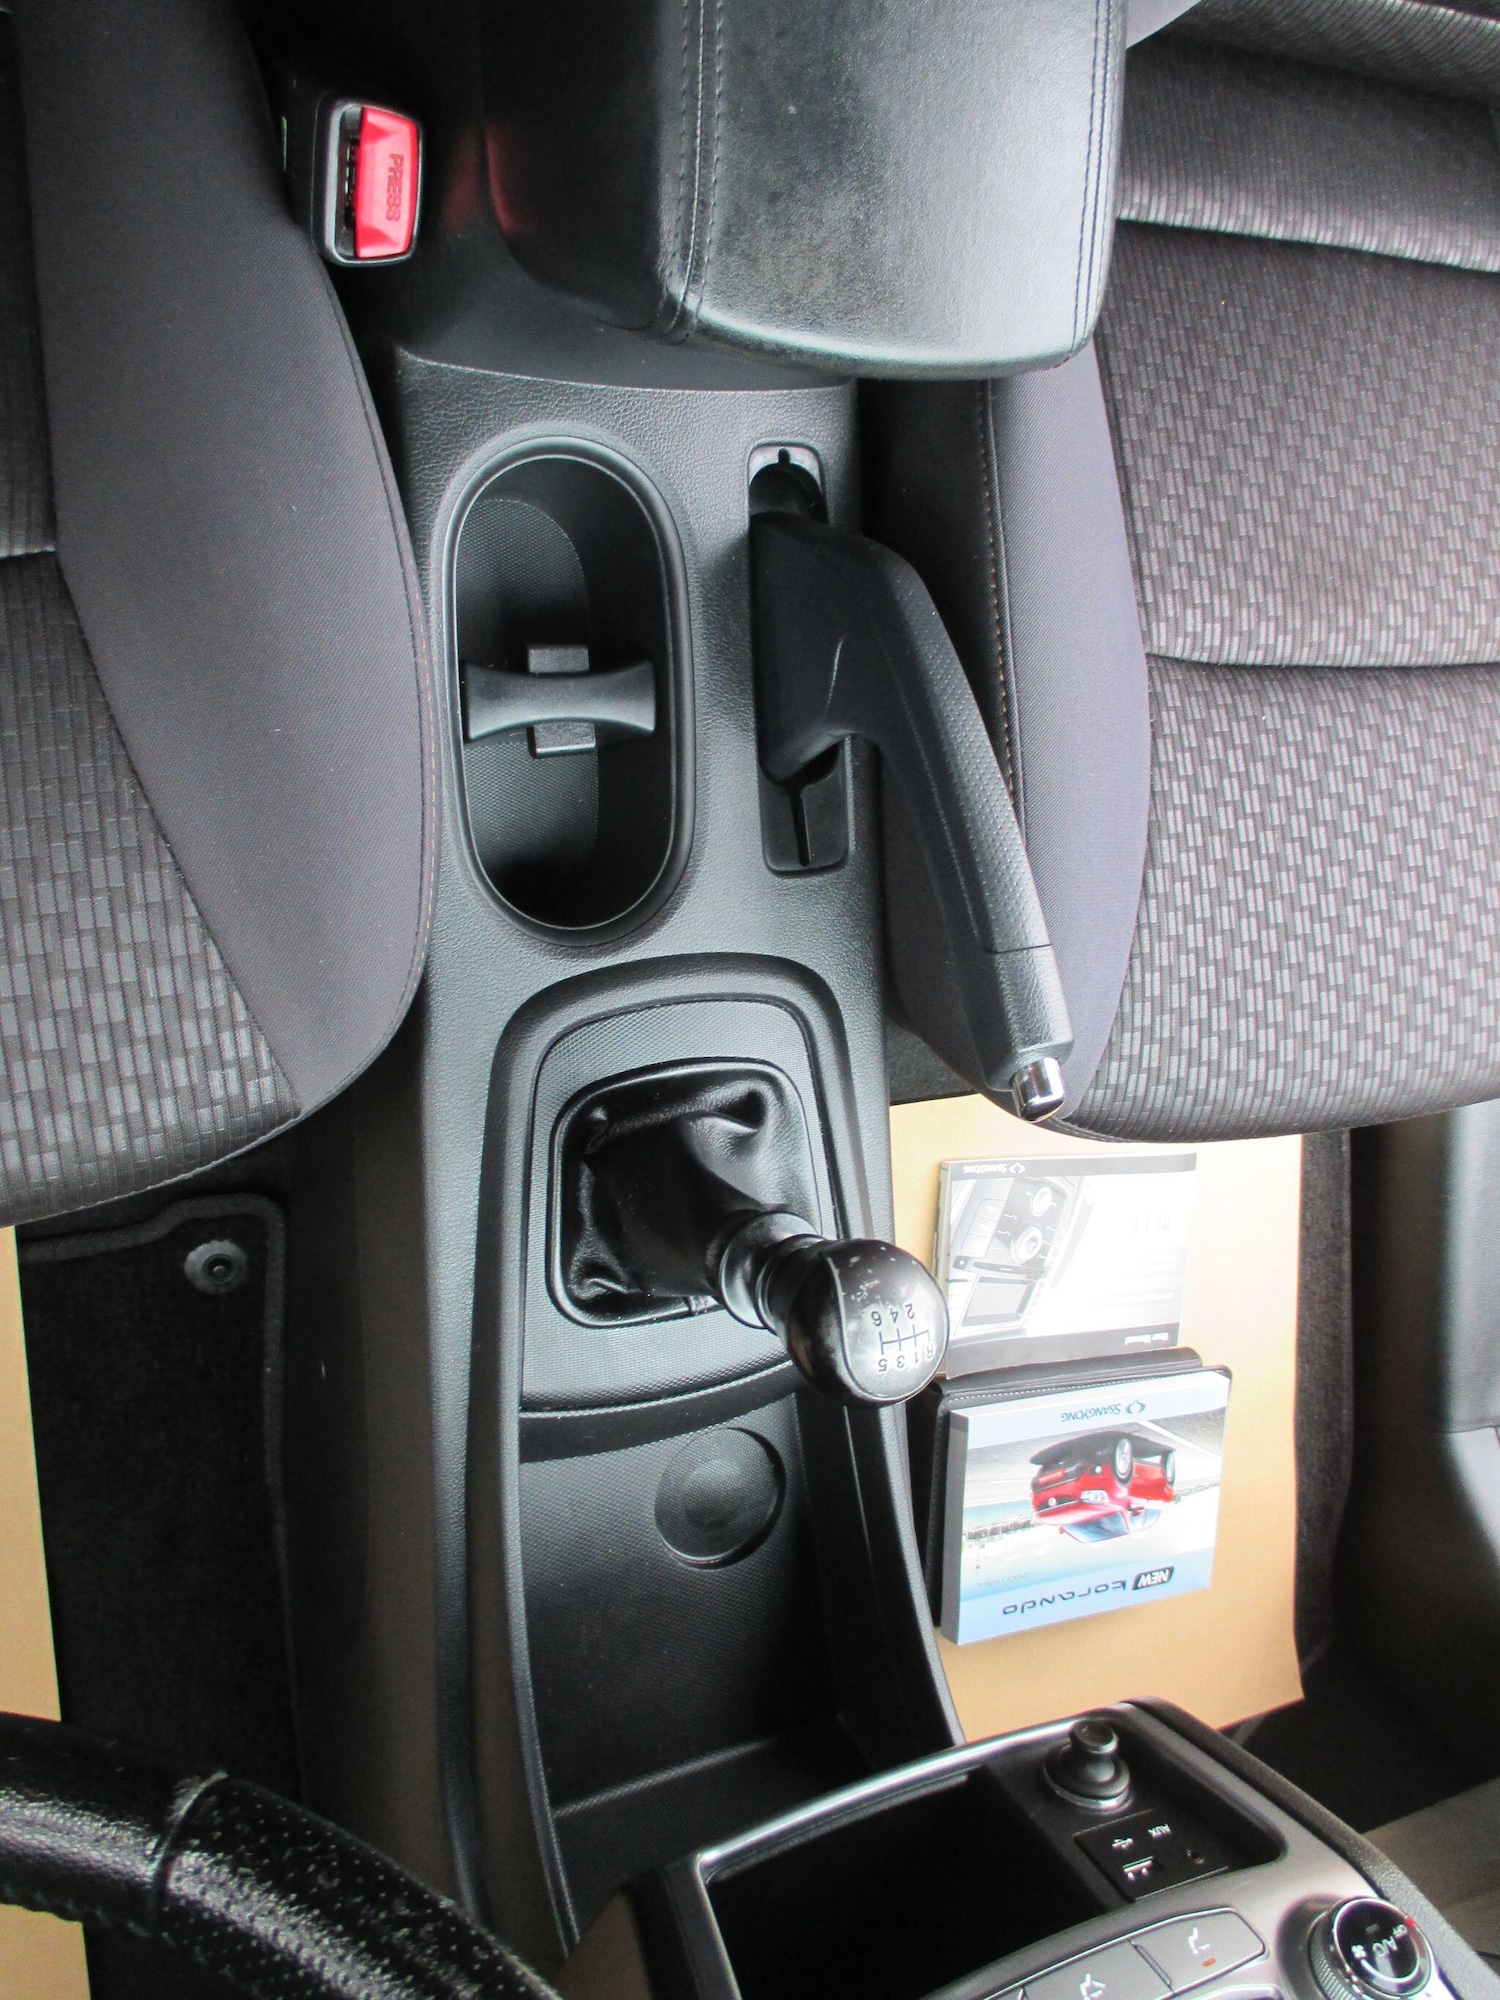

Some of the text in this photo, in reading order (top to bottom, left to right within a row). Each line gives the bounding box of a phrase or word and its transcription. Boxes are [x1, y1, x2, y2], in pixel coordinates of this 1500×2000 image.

[386, 153, 405, 222] PRESS
[870, 1303, 915, 1327] 2 4 6
[877, 1359, 889, 1373] 5
[896, 1355, 906, 1369] 3
[1136, 1568, 1170, 1588] NEW
[1147, 1823, 1171, 1839] AUX
[1372, 1935, 1398, 1957] A/C
